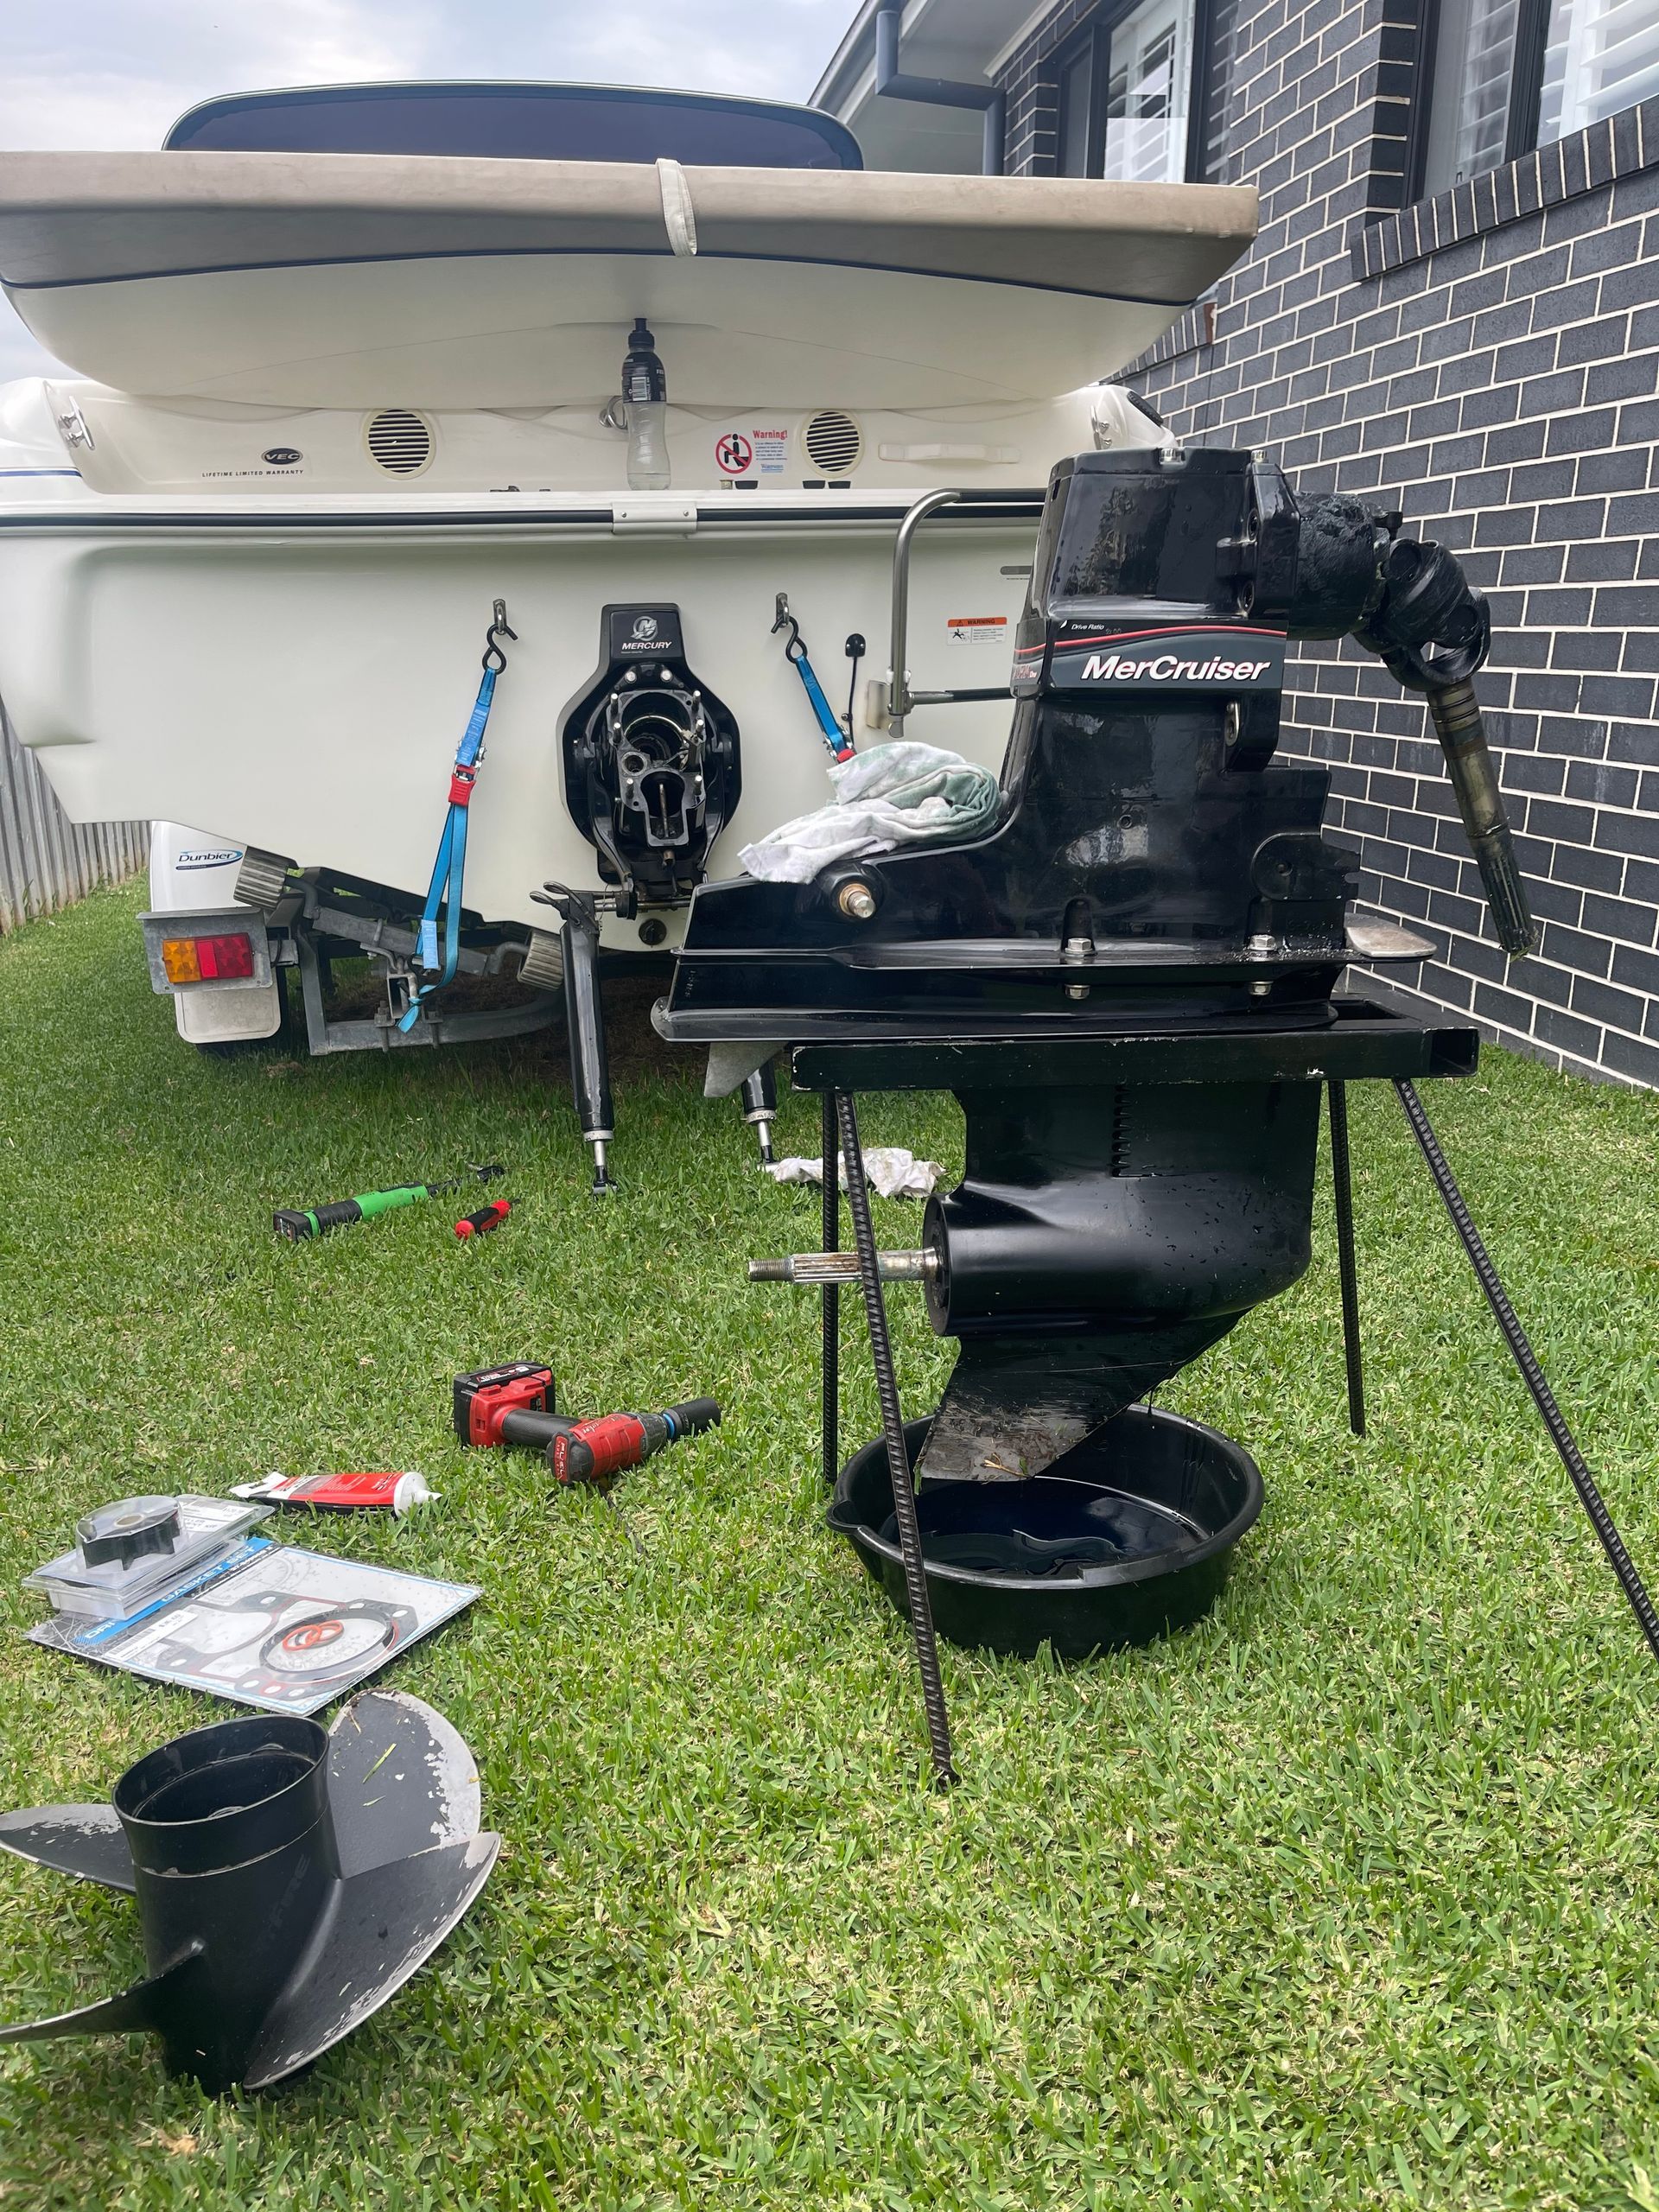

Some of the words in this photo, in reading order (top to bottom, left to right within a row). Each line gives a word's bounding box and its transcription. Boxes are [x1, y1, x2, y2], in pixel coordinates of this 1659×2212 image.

[753, 430, 787, 440] Warning!
[622, 641, 672, 650] MERCURY
[1080, 655, 1271, 681] MerCruiser
[179, 853, 232, 861] Dunbier
[161, 1564, 224, 1602] GASKET
[226, 1545, 255, 1565] SET
